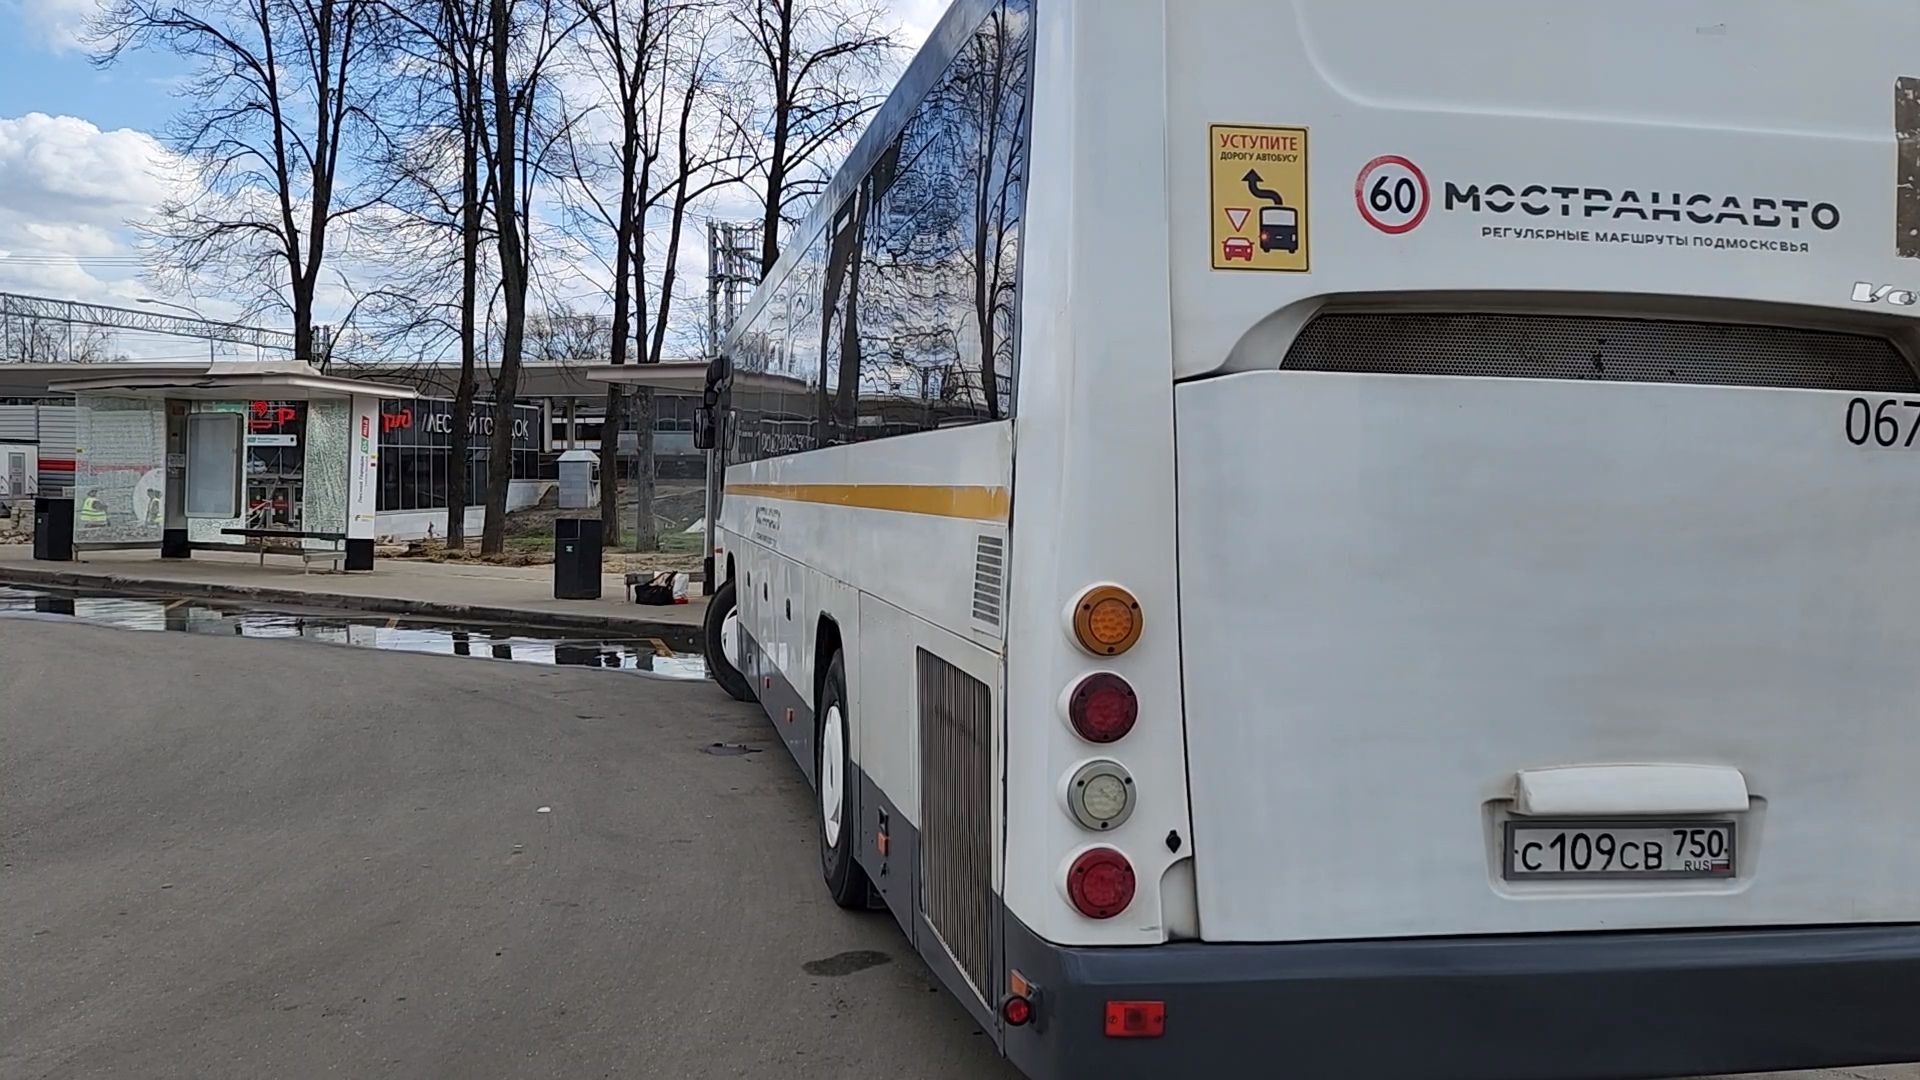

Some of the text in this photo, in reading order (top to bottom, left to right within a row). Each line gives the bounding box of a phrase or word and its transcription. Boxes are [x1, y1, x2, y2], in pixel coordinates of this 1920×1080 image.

[1220, 133, 1298, 151] УСТУПИТЕ
[1220, 151, 1298, 163] ДОРОГУ АВТОБУСУ
[1370, 175, 1417, 214] 60
[1444, 181, 1841, 231] МОСТРАНСАВТО
[1481, 226, 1810, 253] РЕГУЛЯРНЫЕ МАРШРУТЫ ПОДМОСКОВЬЯ
[1845, 397, 1920, 447] 067
[1673, 829, 1724, 858] 750
[1684, 860, 1711, 872] RUS
